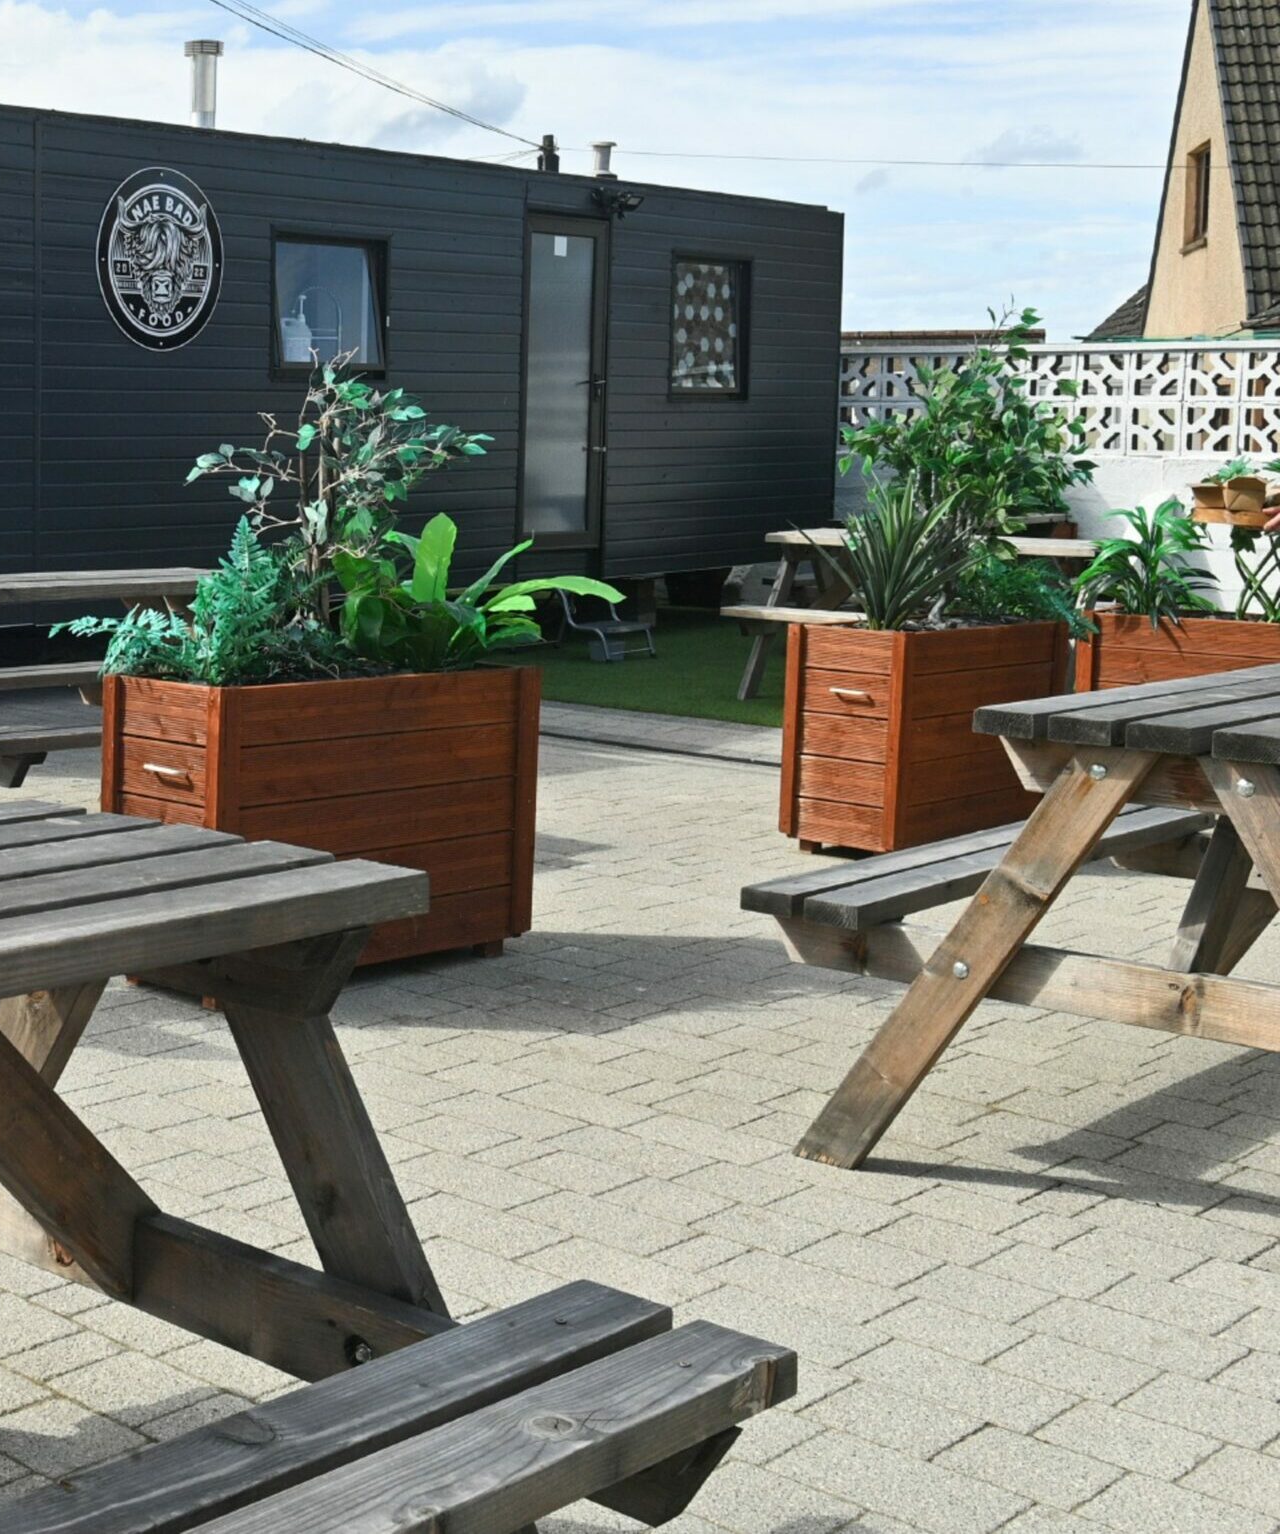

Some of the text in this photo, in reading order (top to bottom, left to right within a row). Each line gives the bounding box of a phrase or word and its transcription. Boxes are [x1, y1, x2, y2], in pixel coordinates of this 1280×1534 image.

[131, 195, 193, 225] NAE BAD
[115, 262, 128, 273] 20
[194, 267, 205, 278] 22
[137, 308, 184, 327] FOOD
